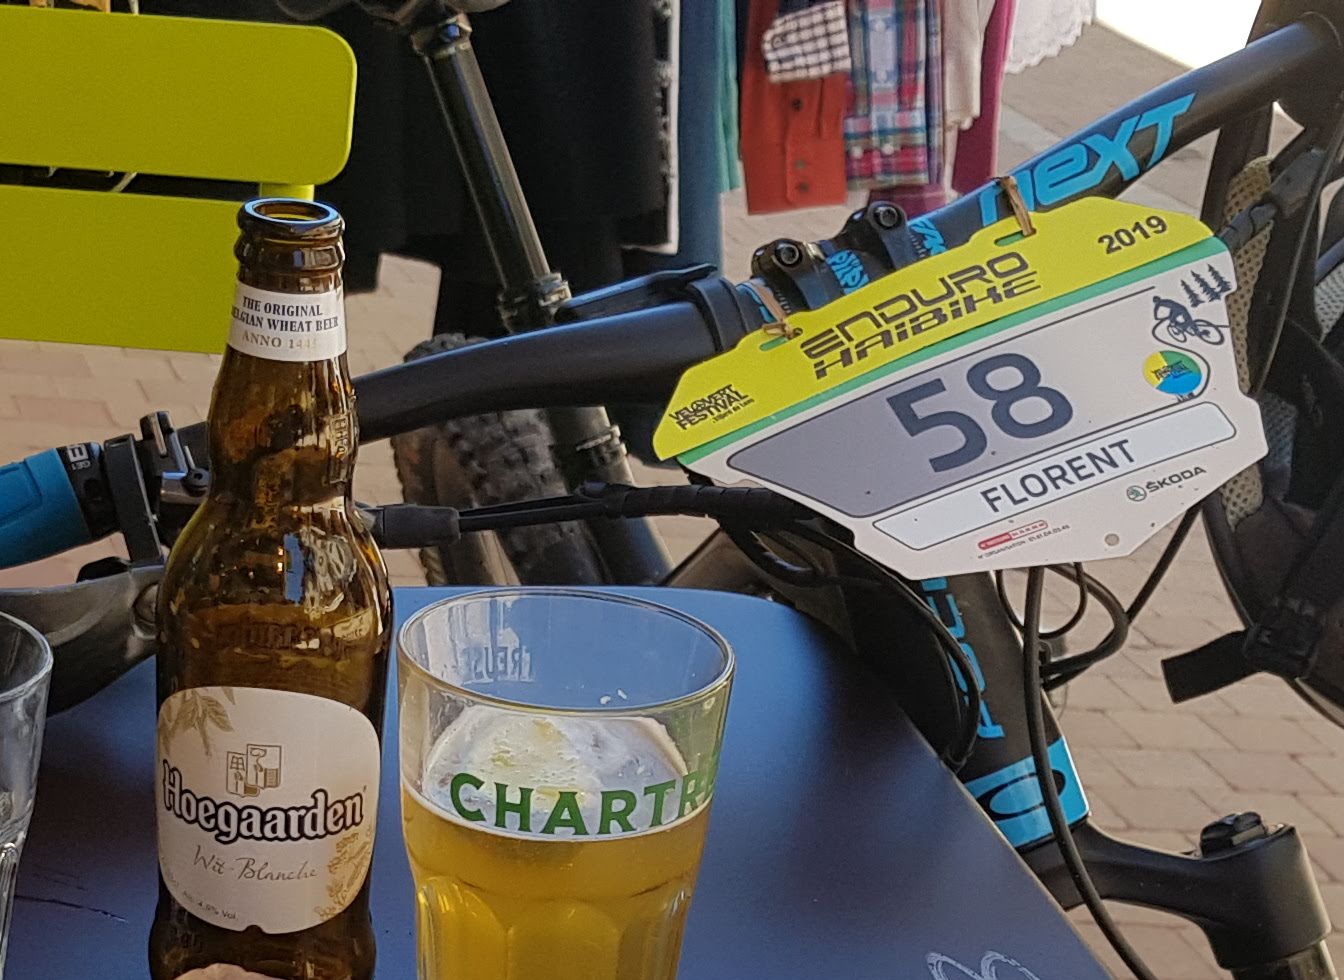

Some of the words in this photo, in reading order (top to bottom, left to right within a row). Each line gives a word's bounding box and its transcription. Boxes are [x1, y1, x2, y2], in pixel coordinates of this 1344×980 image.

[1097, 215, 1168, 255] 2019
[242, 295, 262, 312] THE
[263, 302, 323, 317] ORIGINAL
[267, 318, 312, 332] WHEAT
[315, 316, 339, 332] BEER
[800, 251, 1029, 359] ENDURO
[242, 330, 282, 347] ANNO
[676, 390, 749, 430] FESTIVAL
[886, 353, 1083, 472] 58
[980, 439, 1135, 513] FLORENT
[162, 759, 364, 845] Hoegaarden
